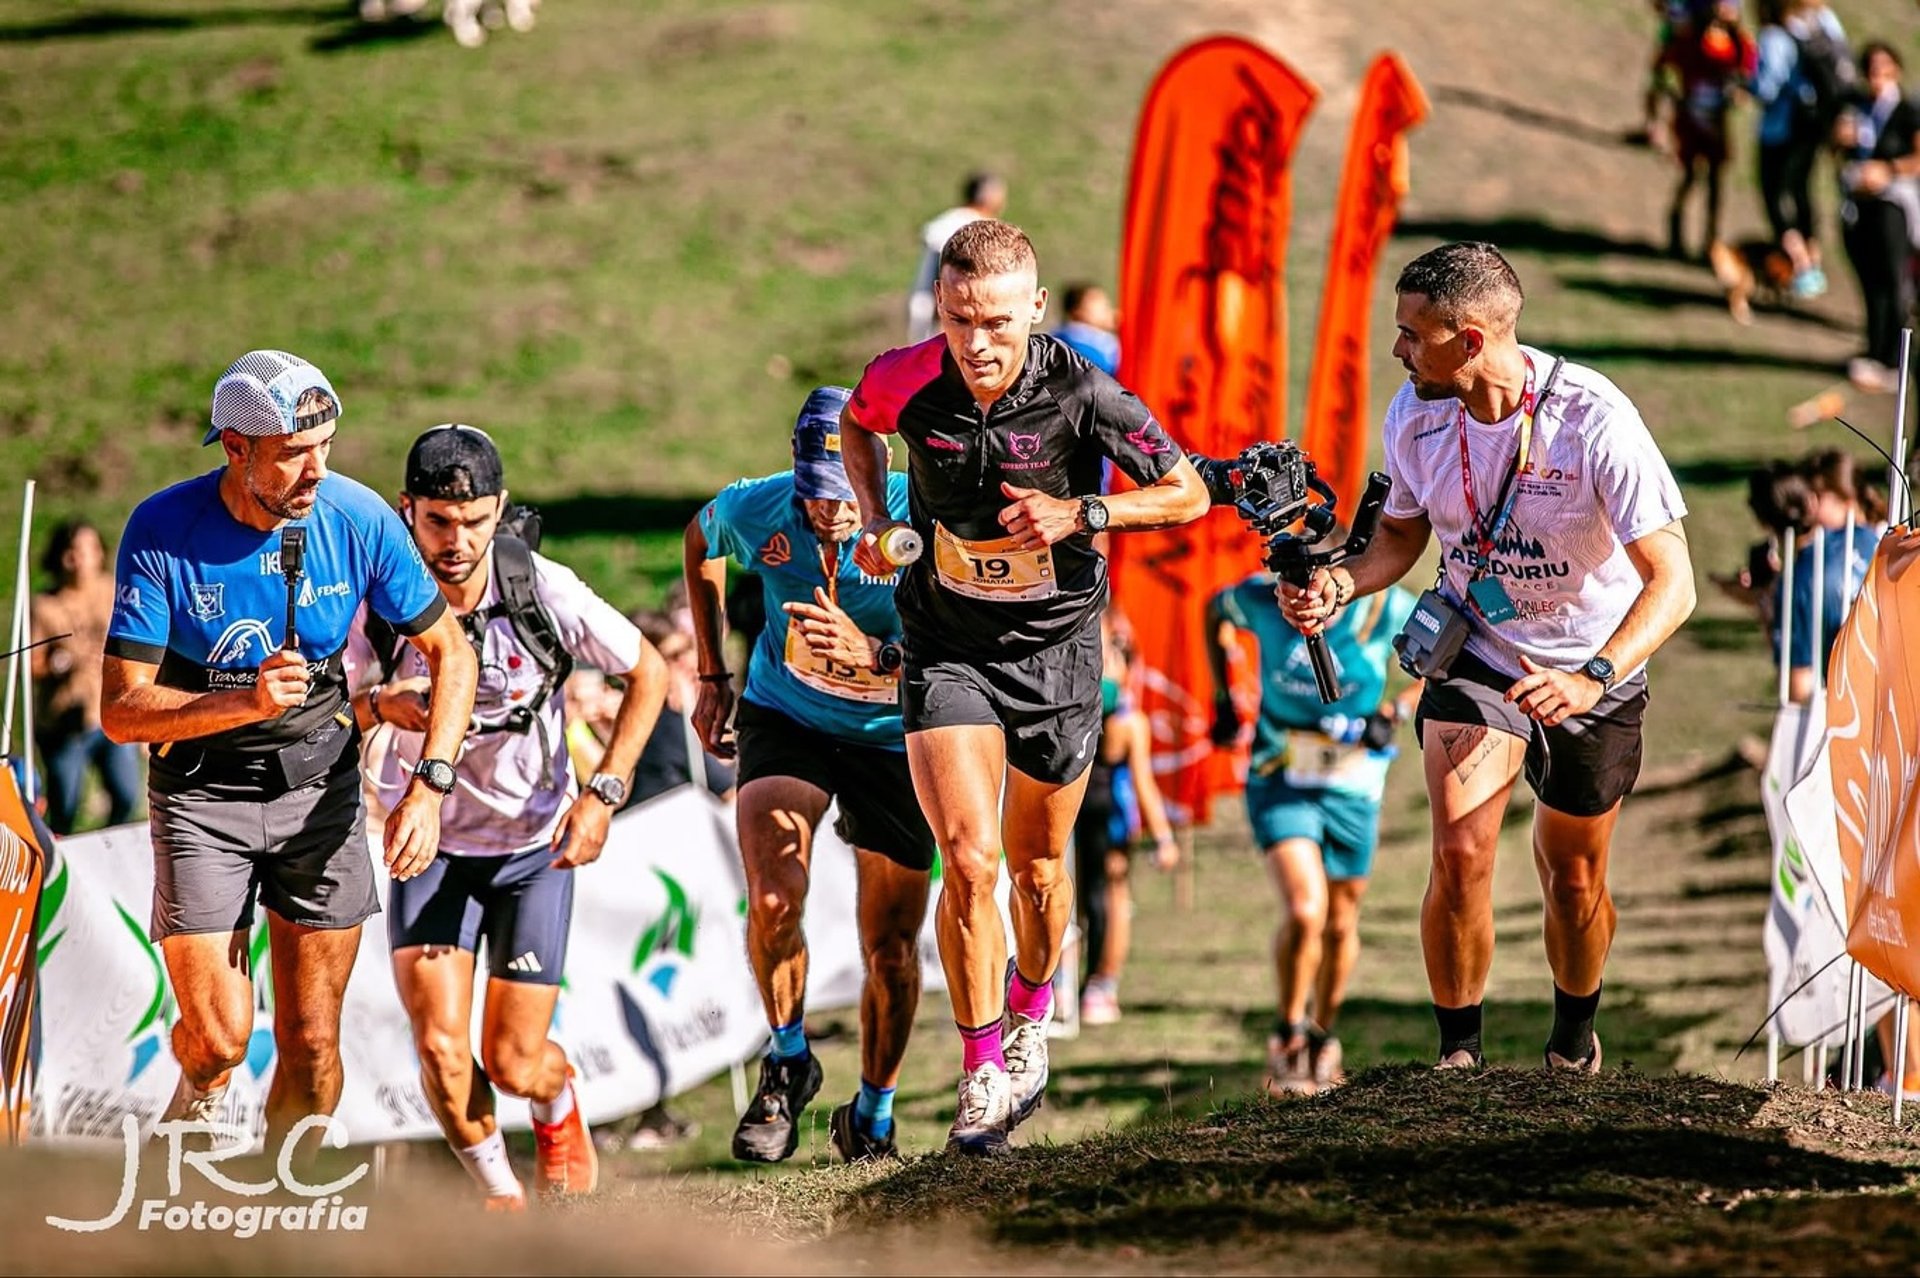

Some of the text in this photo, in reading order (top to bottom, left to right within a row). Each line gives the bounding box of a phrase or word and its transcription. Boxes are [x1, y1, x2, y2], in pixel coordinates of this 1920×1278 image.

[1029, 460, 1050, 469] TEAM
[968, 558, 1011, 579] 19
[1450, 546, 1569, 580] ABDURIU
